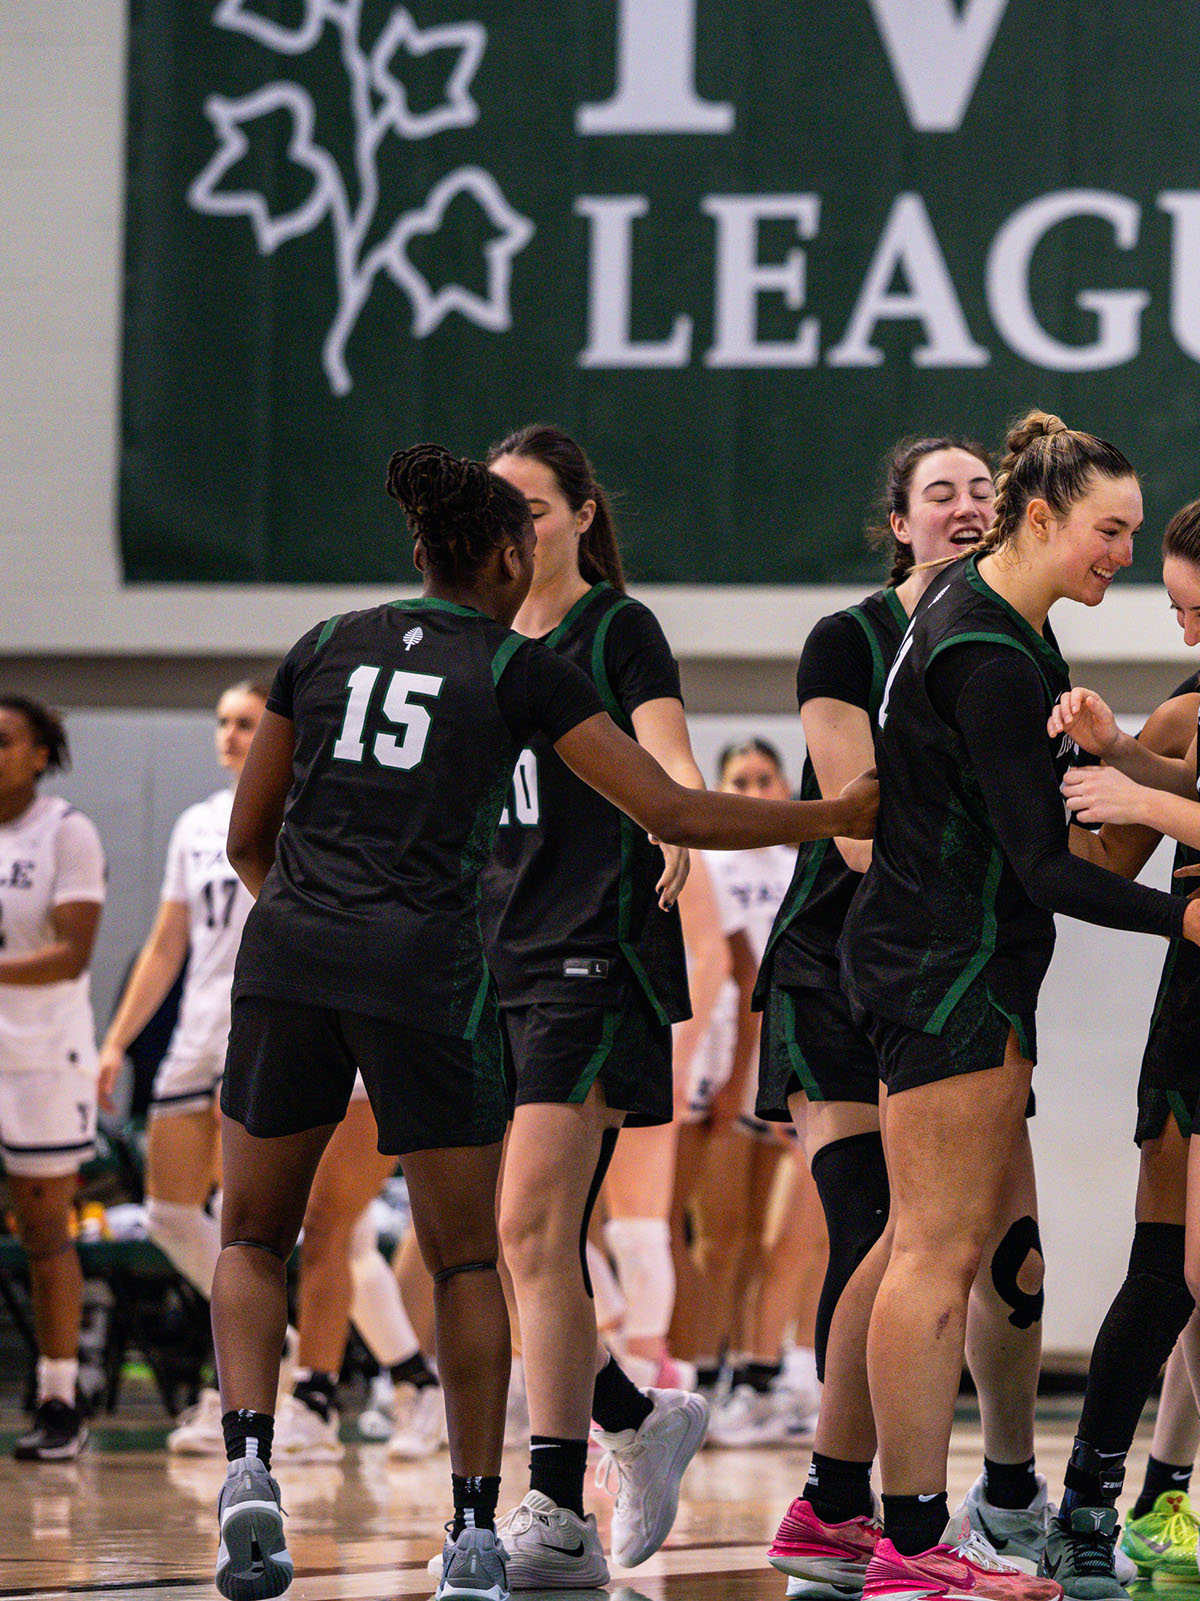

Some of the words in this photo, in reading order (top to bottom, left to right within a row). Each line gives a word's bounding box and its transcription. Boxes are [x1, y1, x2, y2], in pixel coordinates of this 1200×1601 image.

[332, 664, 446, 772] 15
[499, 748, 540, 825] 0
[202, 879, 239, 929] 17
